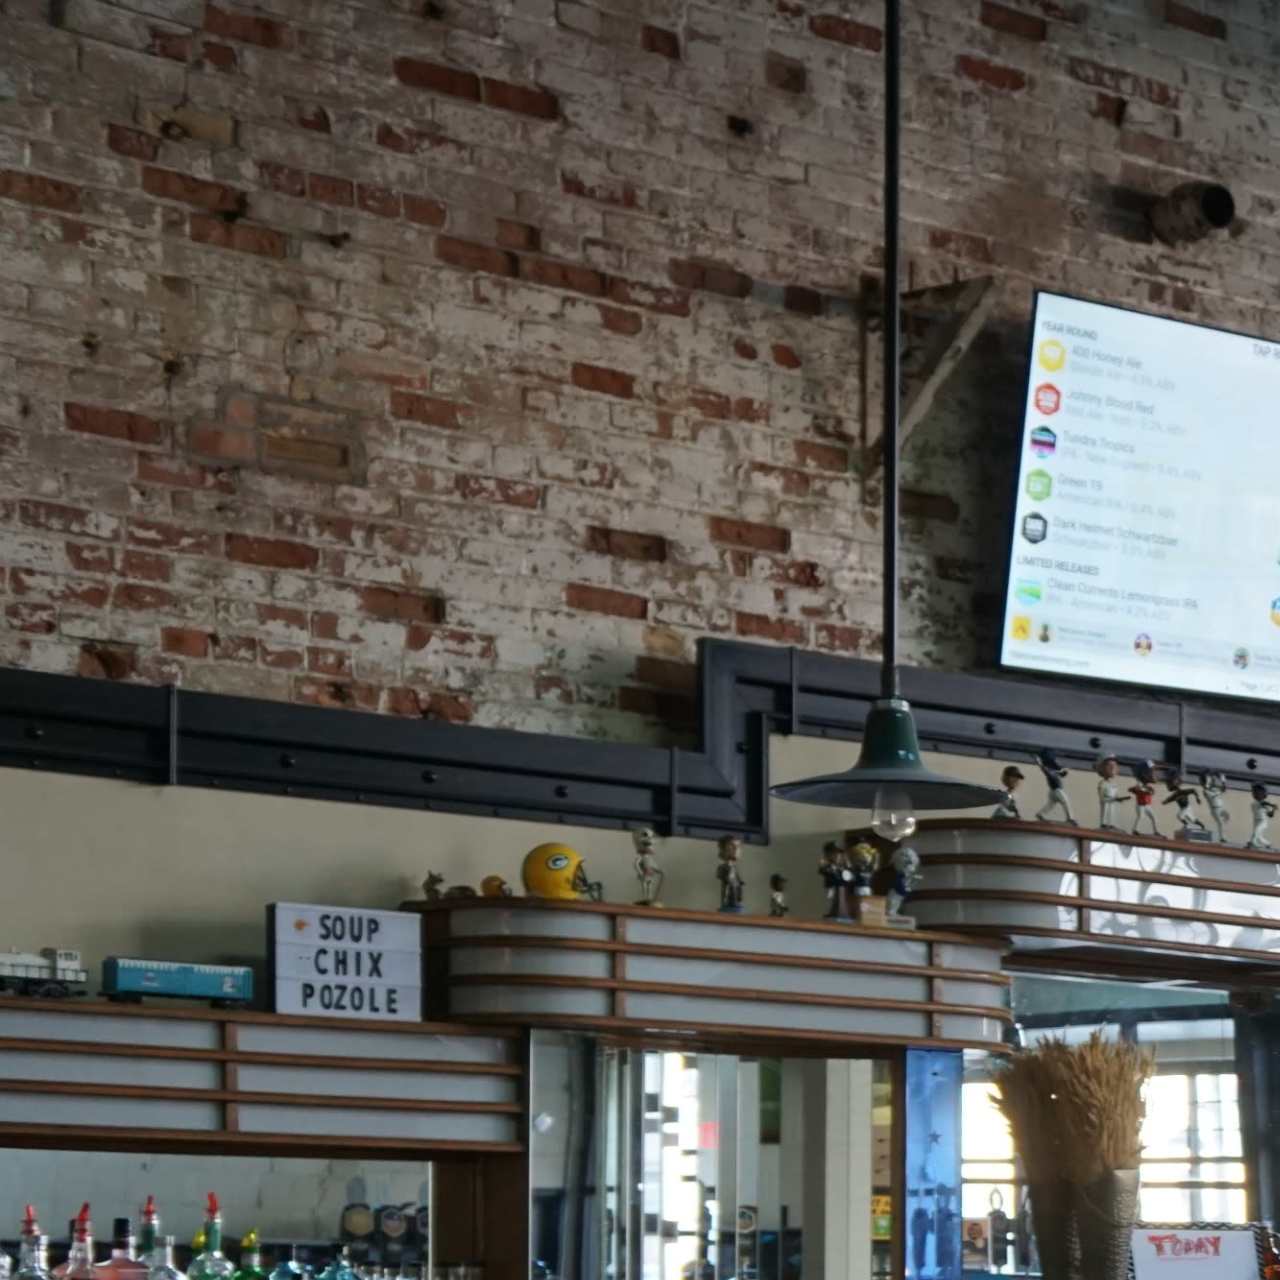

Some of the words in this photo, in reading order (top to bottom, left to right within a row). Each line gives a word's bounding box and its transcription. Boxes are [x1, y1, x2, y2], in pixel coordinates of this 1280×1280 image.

[1041, 319, 1063, 333] YEAR
[1065, 324, 1098, 341] ROUND
[1252, 343, 1271, 355] TAP
[1057, 472, 1087, 488] Green
[1016, 553, 1053, 569] LIMITED
[1054, 559, 1100, 576] RELEASES
[319, 914, 380, 943] SOUP
[314, 948, 383, 978] CHIX
[302, 983, 398, 1014] POZOLE
[1148, 1234, 1222, 1257] TODAY
